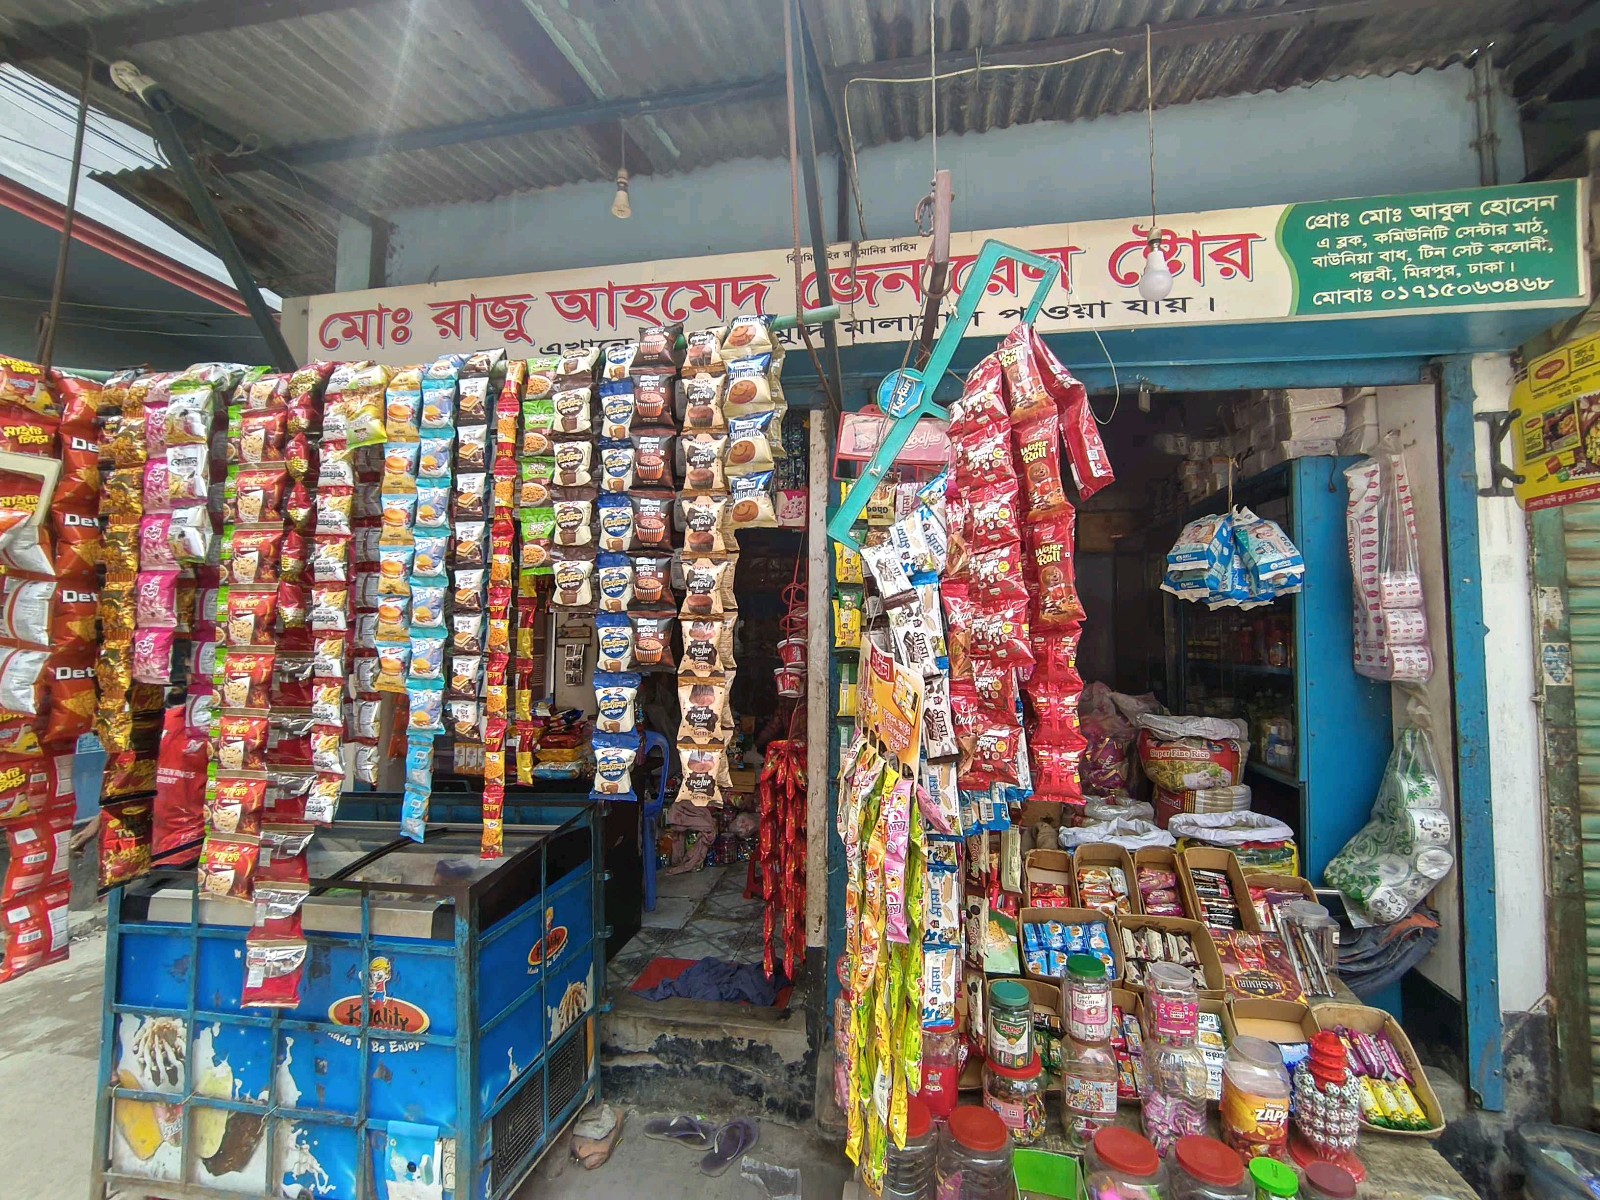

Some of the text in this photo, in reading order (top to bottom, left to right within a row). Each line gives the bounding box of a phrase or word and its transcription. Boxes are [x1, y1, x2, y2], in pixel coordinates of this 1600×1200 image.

[1304, 194, 1559, 231] প্রোঃ মোঃ আবুল হোসেন
[1316, 217, 1548, 250] এ ব্লক, কমিউনিটি সেন্টার মাঠ,
[1310, 246, 1374, 268] বাউনিয়া
[1379, 249, 1412, 264] বাধ,
[1418, 244, 1446, 260] টিন
[1452, 241, 1485, 257] সেট
[1349, 267, 1398, 284] পল্লবী,
[1403, 262, 1462, 281] মিরপুর,
[1466, 260, 1505, 275] ঢাকা
[1121, 294, 1196, 316] যায়
[1312, 286, 1373, 307] মোবাঃ
[318, 302, 413, 350] মোঃ
[427, 292, 539, 346] রাজু
[539, 273, 781, 333] আহমেদ
[71, 436, 99, 453] De
[1020, 440, 1049, 458] Wafer
[1022, 446, 1047, 464] Roll
[64, 513, 99, 528] Det
[1034, 543, 1064, 557] Wafer
[1036, 548, 1061, 566] Roll
[62, 589, 98, 603] Det
[55, 666, 96, 681] Det
[1171, 750, 1190, 759] Fine
[1191, 750, 1210, 759] Rice
[929, 966, 942, 995] মামা
[1236, 979, 1283, 991] KASHMIRI
[348, 1002, 410, 1031] Kality
[371, 1041, 386, 1053] Be
